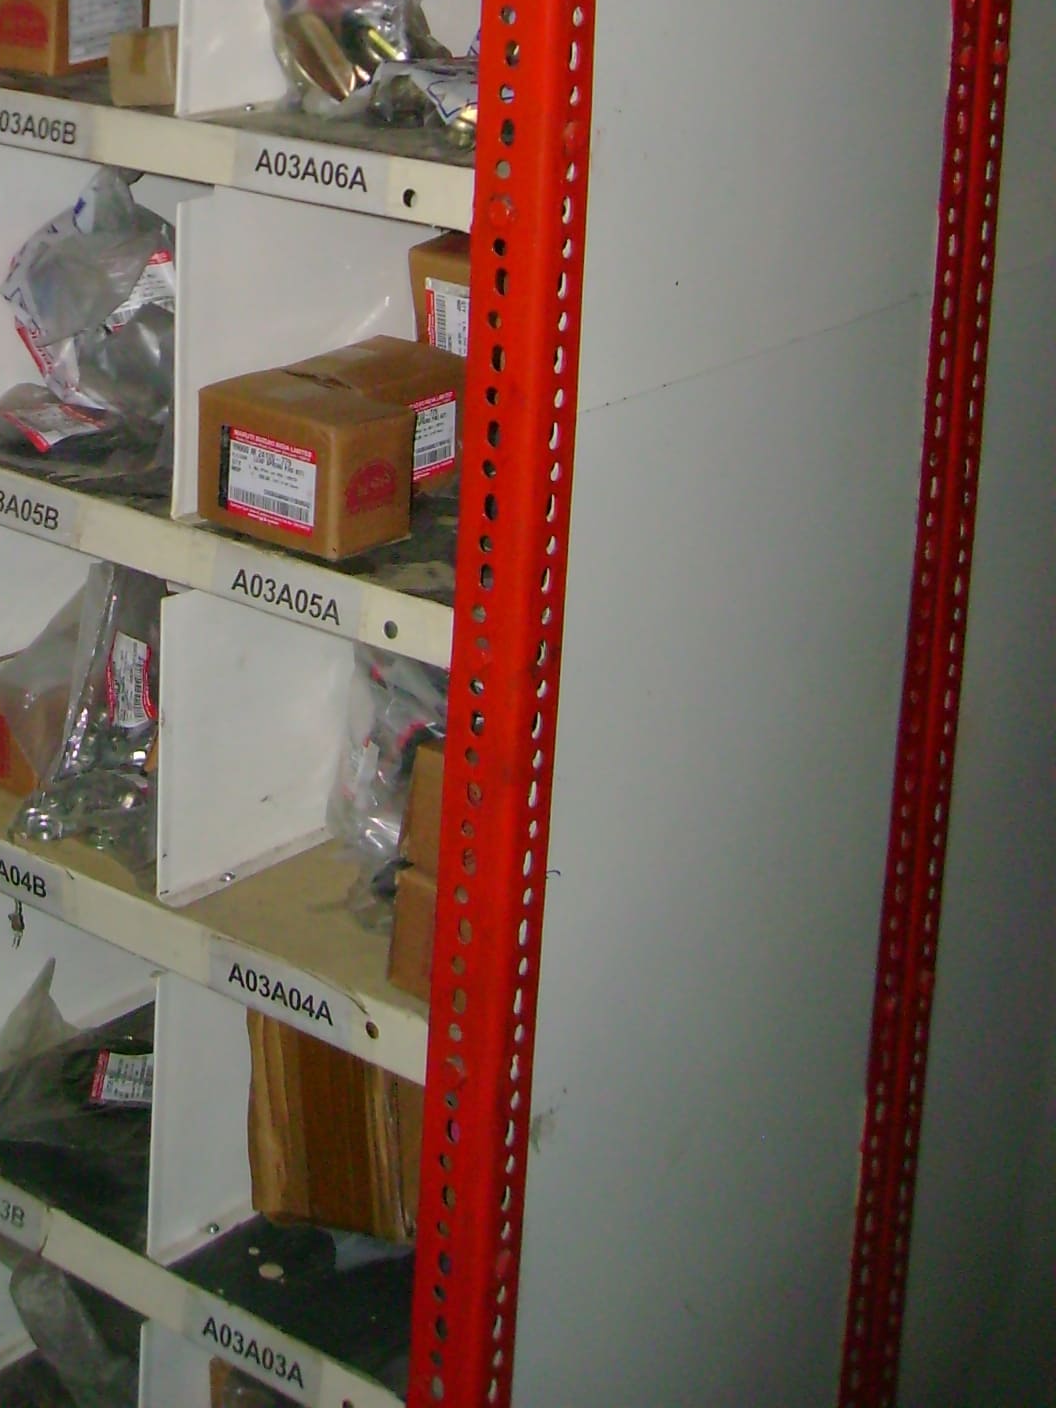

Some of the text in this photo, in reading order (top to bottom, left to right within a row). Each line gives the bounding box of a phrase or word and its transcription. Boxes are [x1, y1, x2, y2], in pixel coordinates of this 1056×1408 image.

[254, 147, 369, 194] A03A06A
[230, 566, 342, 628] A03A05A
[227, 960, 335, 1029] A03A04A
[201, 1314, 306, 1391] A03A03A
